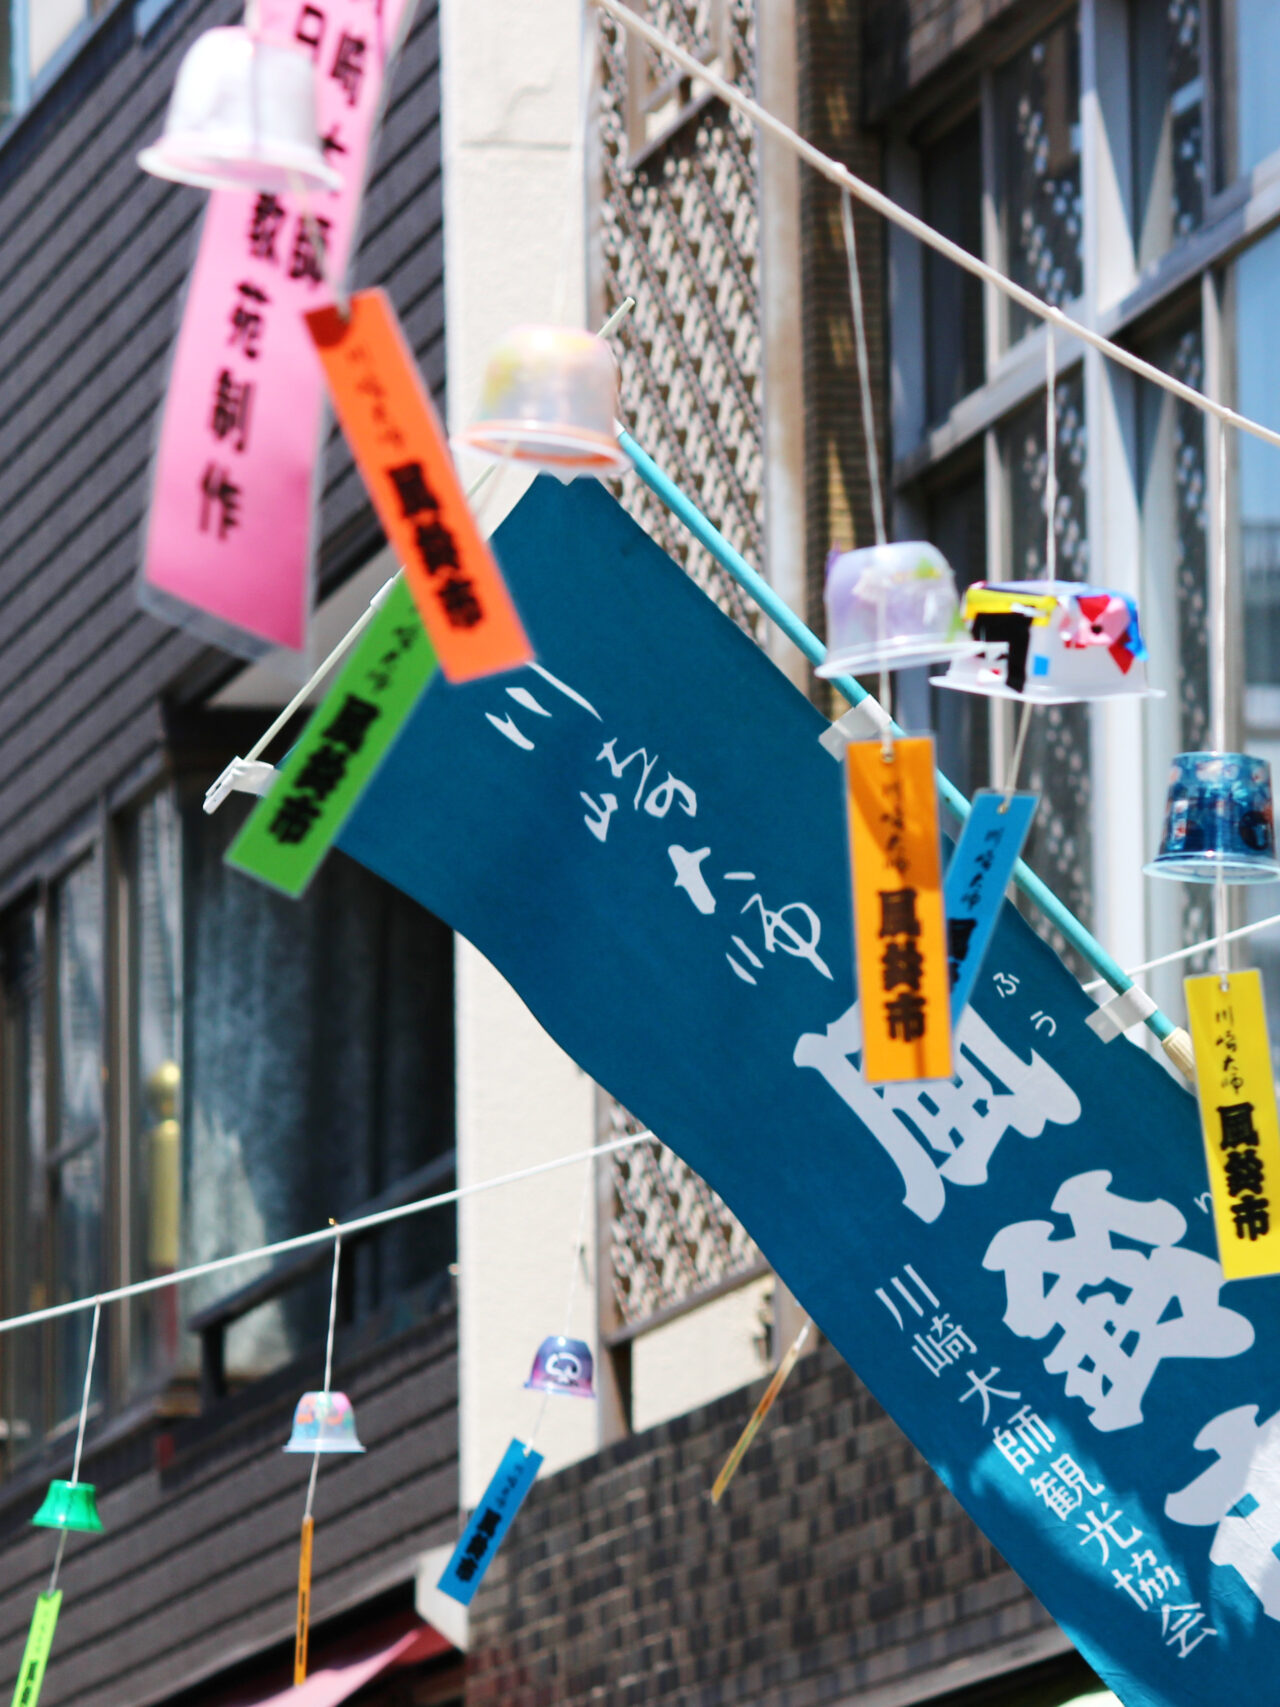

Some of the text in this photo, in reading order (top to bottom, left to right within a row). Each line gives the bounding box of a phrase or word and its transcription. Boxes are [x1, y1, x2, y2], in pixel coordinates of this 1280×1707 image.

[1216, 1101, 1270, 1241] 風鈴市
[875, 1263, 1218, 1658] 川崎大師観光協会
